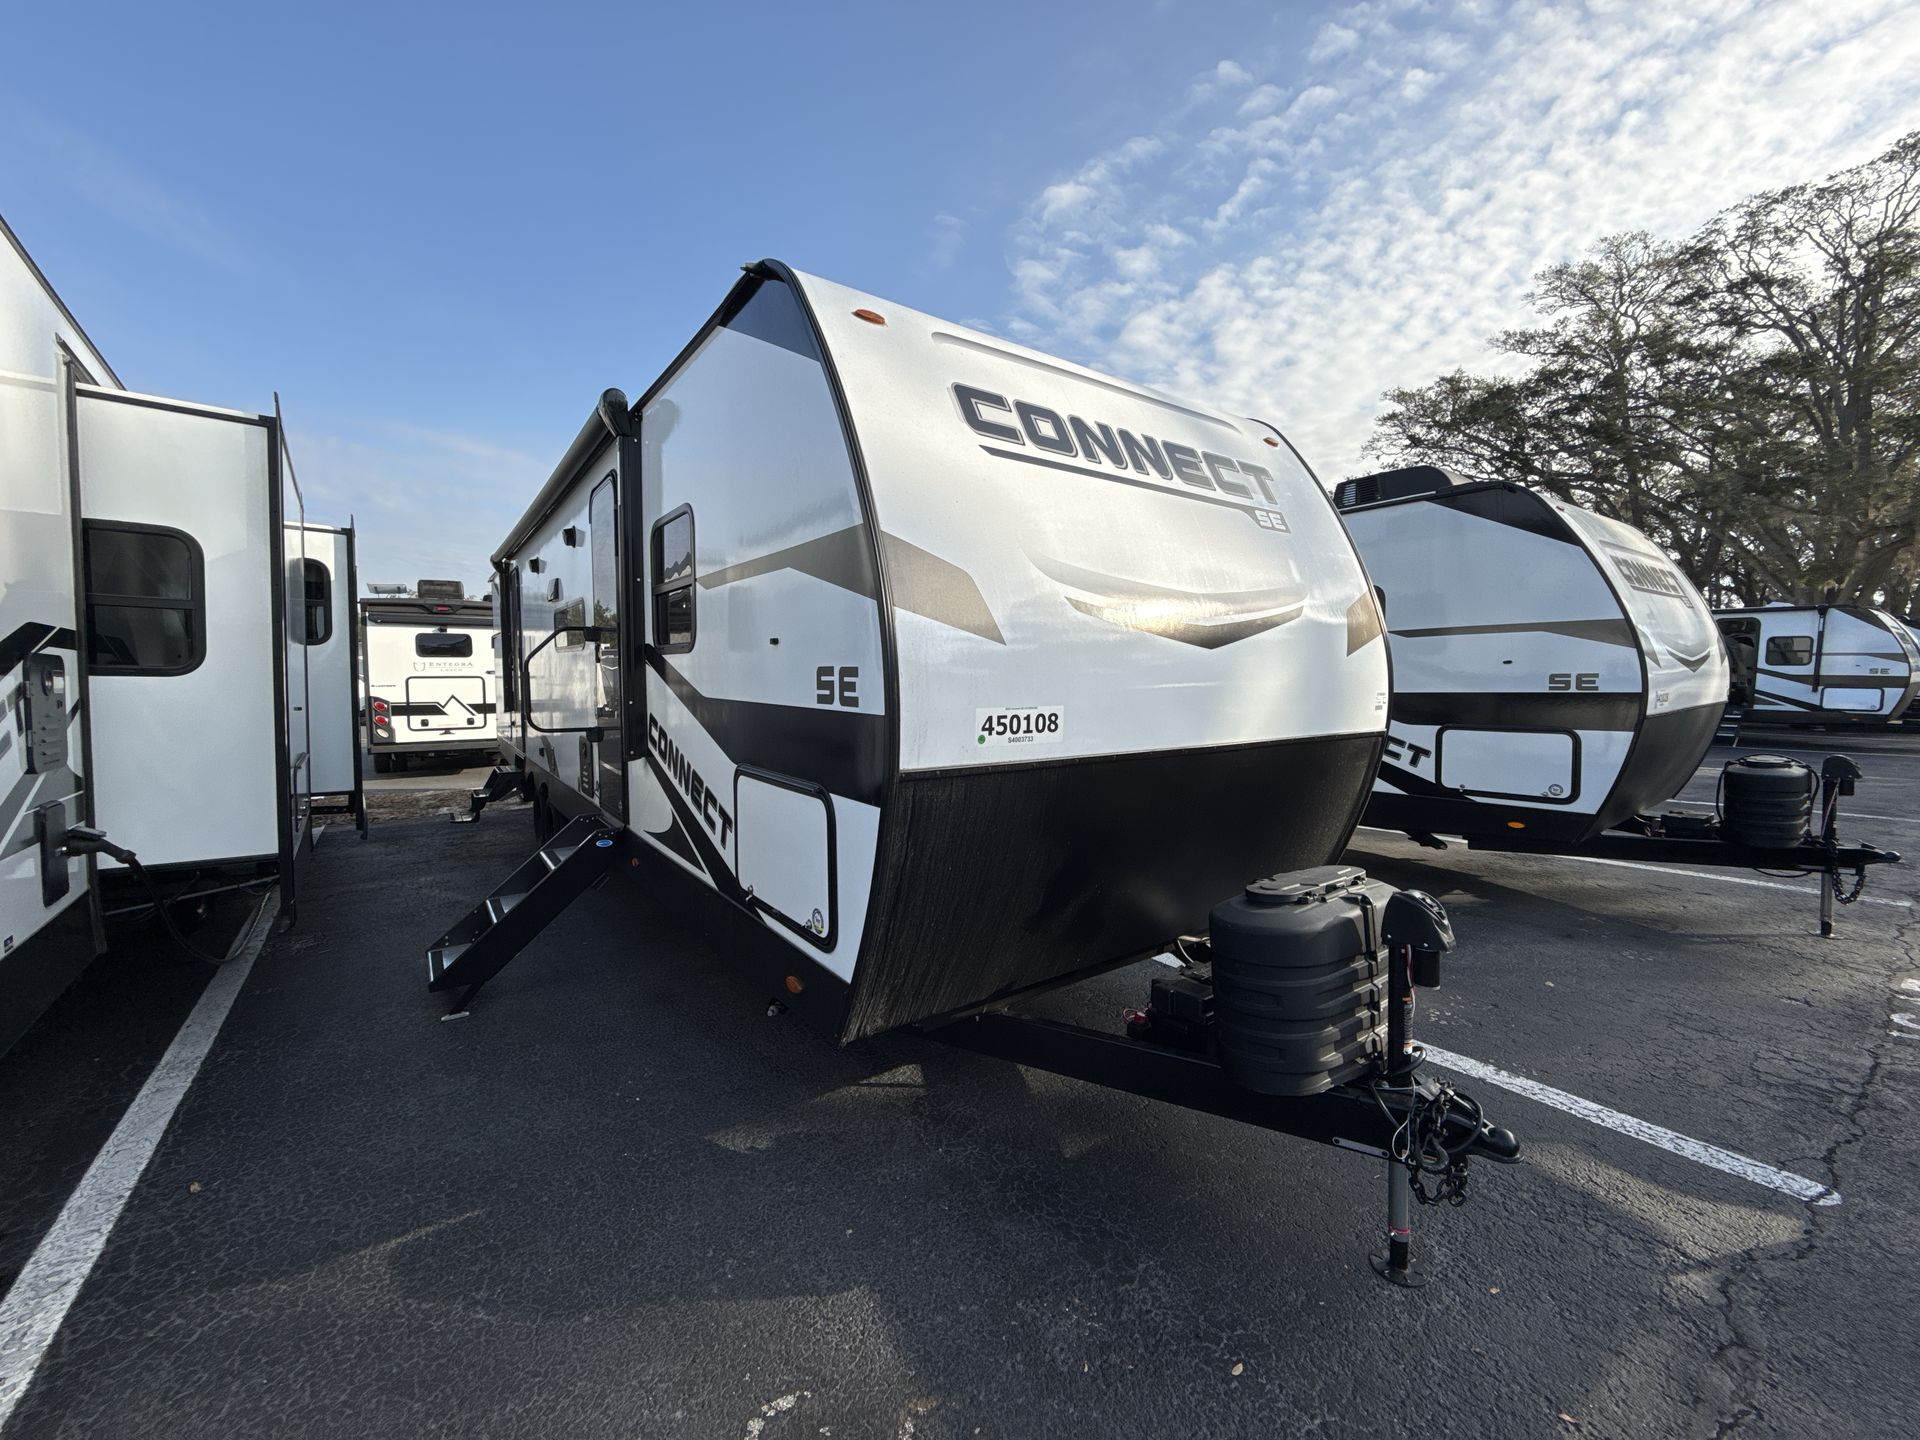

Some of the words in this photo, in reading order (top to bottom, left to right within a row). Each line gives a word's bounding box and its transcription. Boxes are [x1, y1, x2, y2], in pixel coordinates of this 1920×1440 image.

[948, 382, 1278, 504] CONNECT
[1254, 509, 1287, 531] SE
[816, 665, 860, 708] SE
[1549, 673, 1600, 691] SE
[981, 712, 1059, 736] 450108
[1384, 735, 1432, 768] CT
[649, 712, 733, 850] CONNECT
